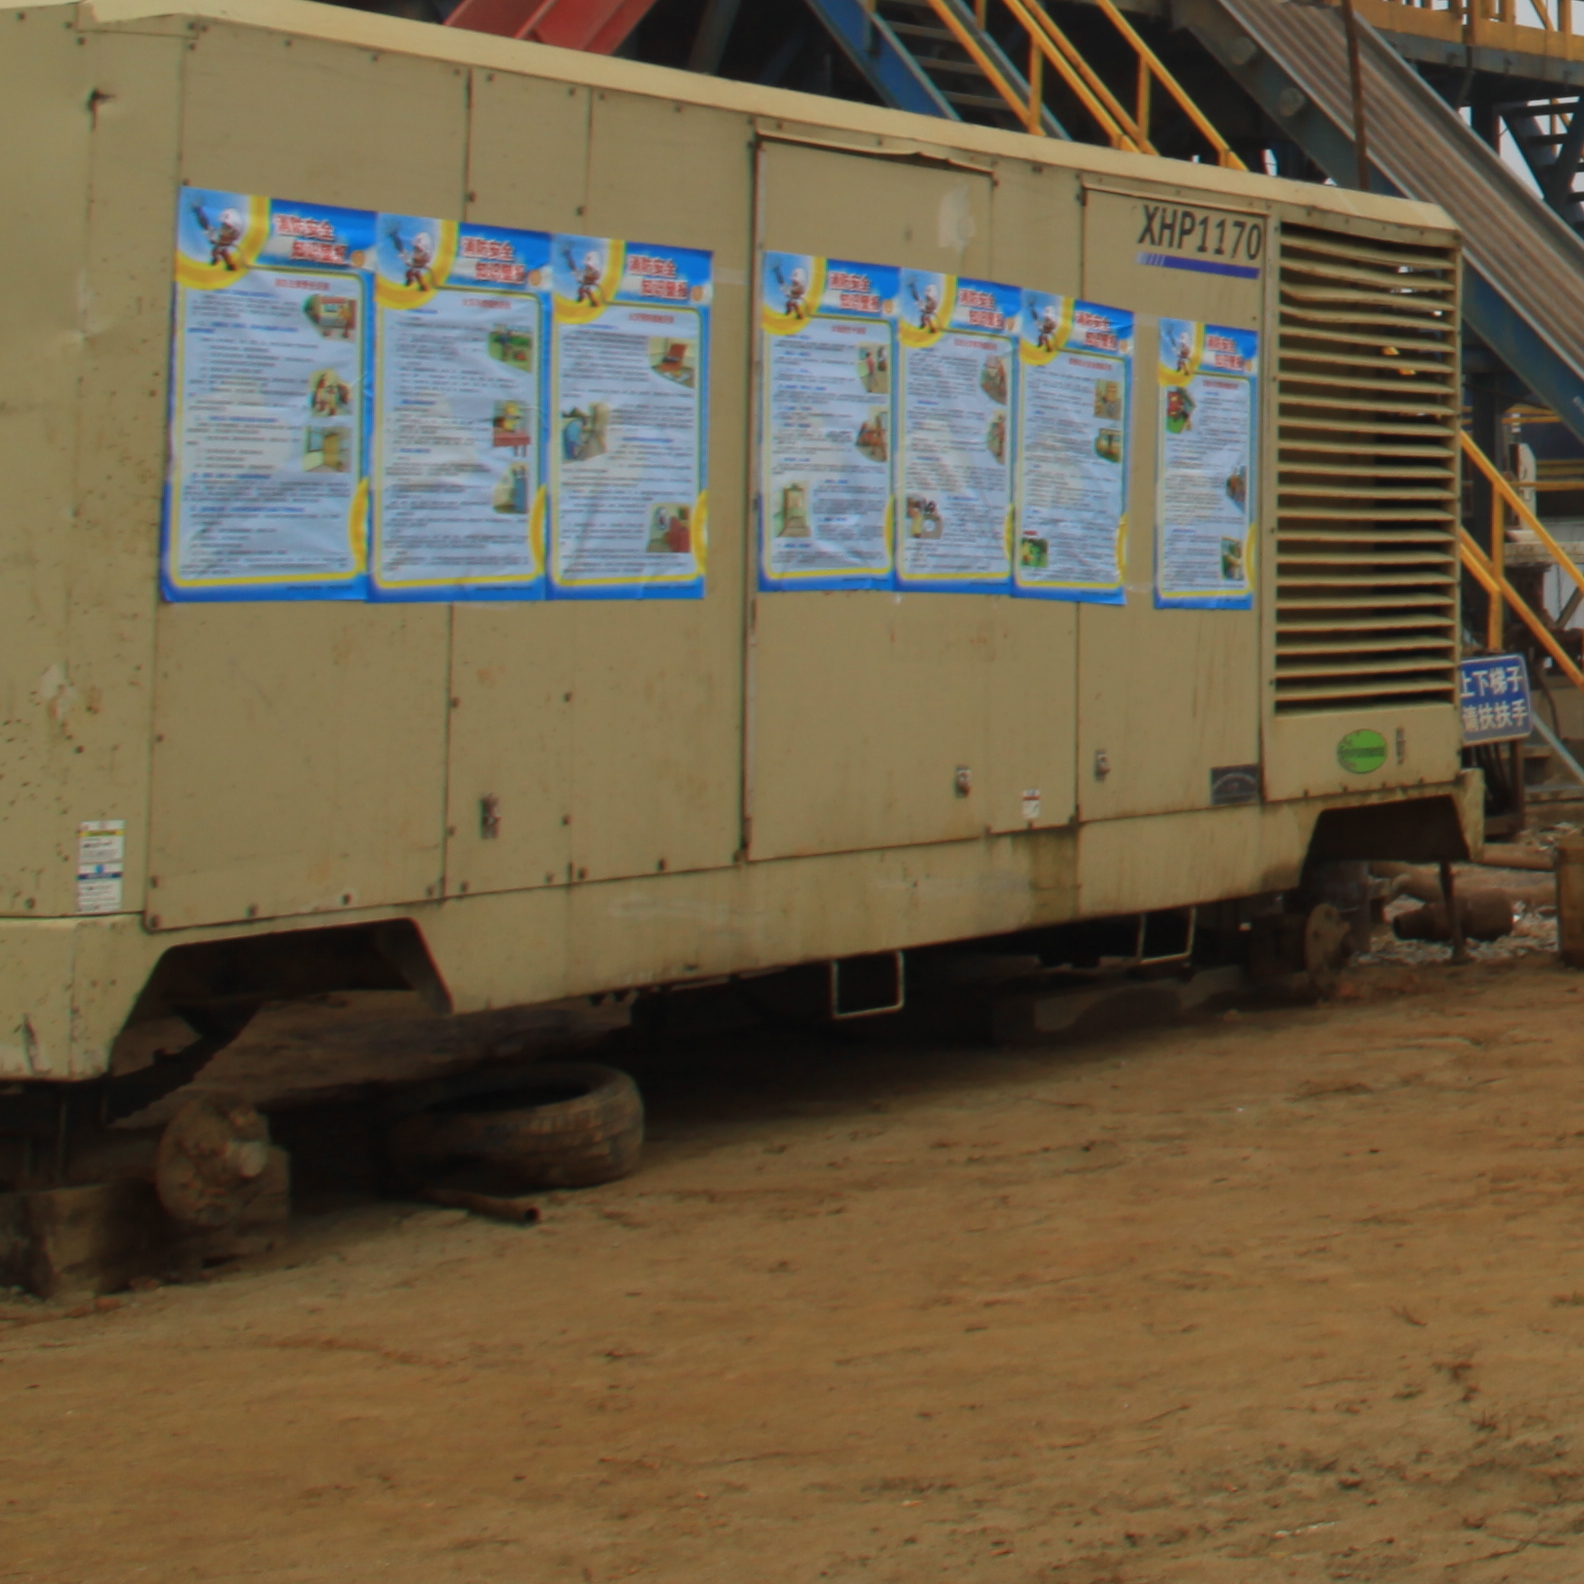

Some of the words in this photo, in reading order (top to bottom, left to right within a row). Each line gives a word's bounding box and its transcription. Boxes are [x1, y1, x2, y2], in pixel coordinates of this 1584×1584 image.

[1138, 204, 1261, 260] XHP1170
[1460, 666, 1523, 697] 上下梯子
